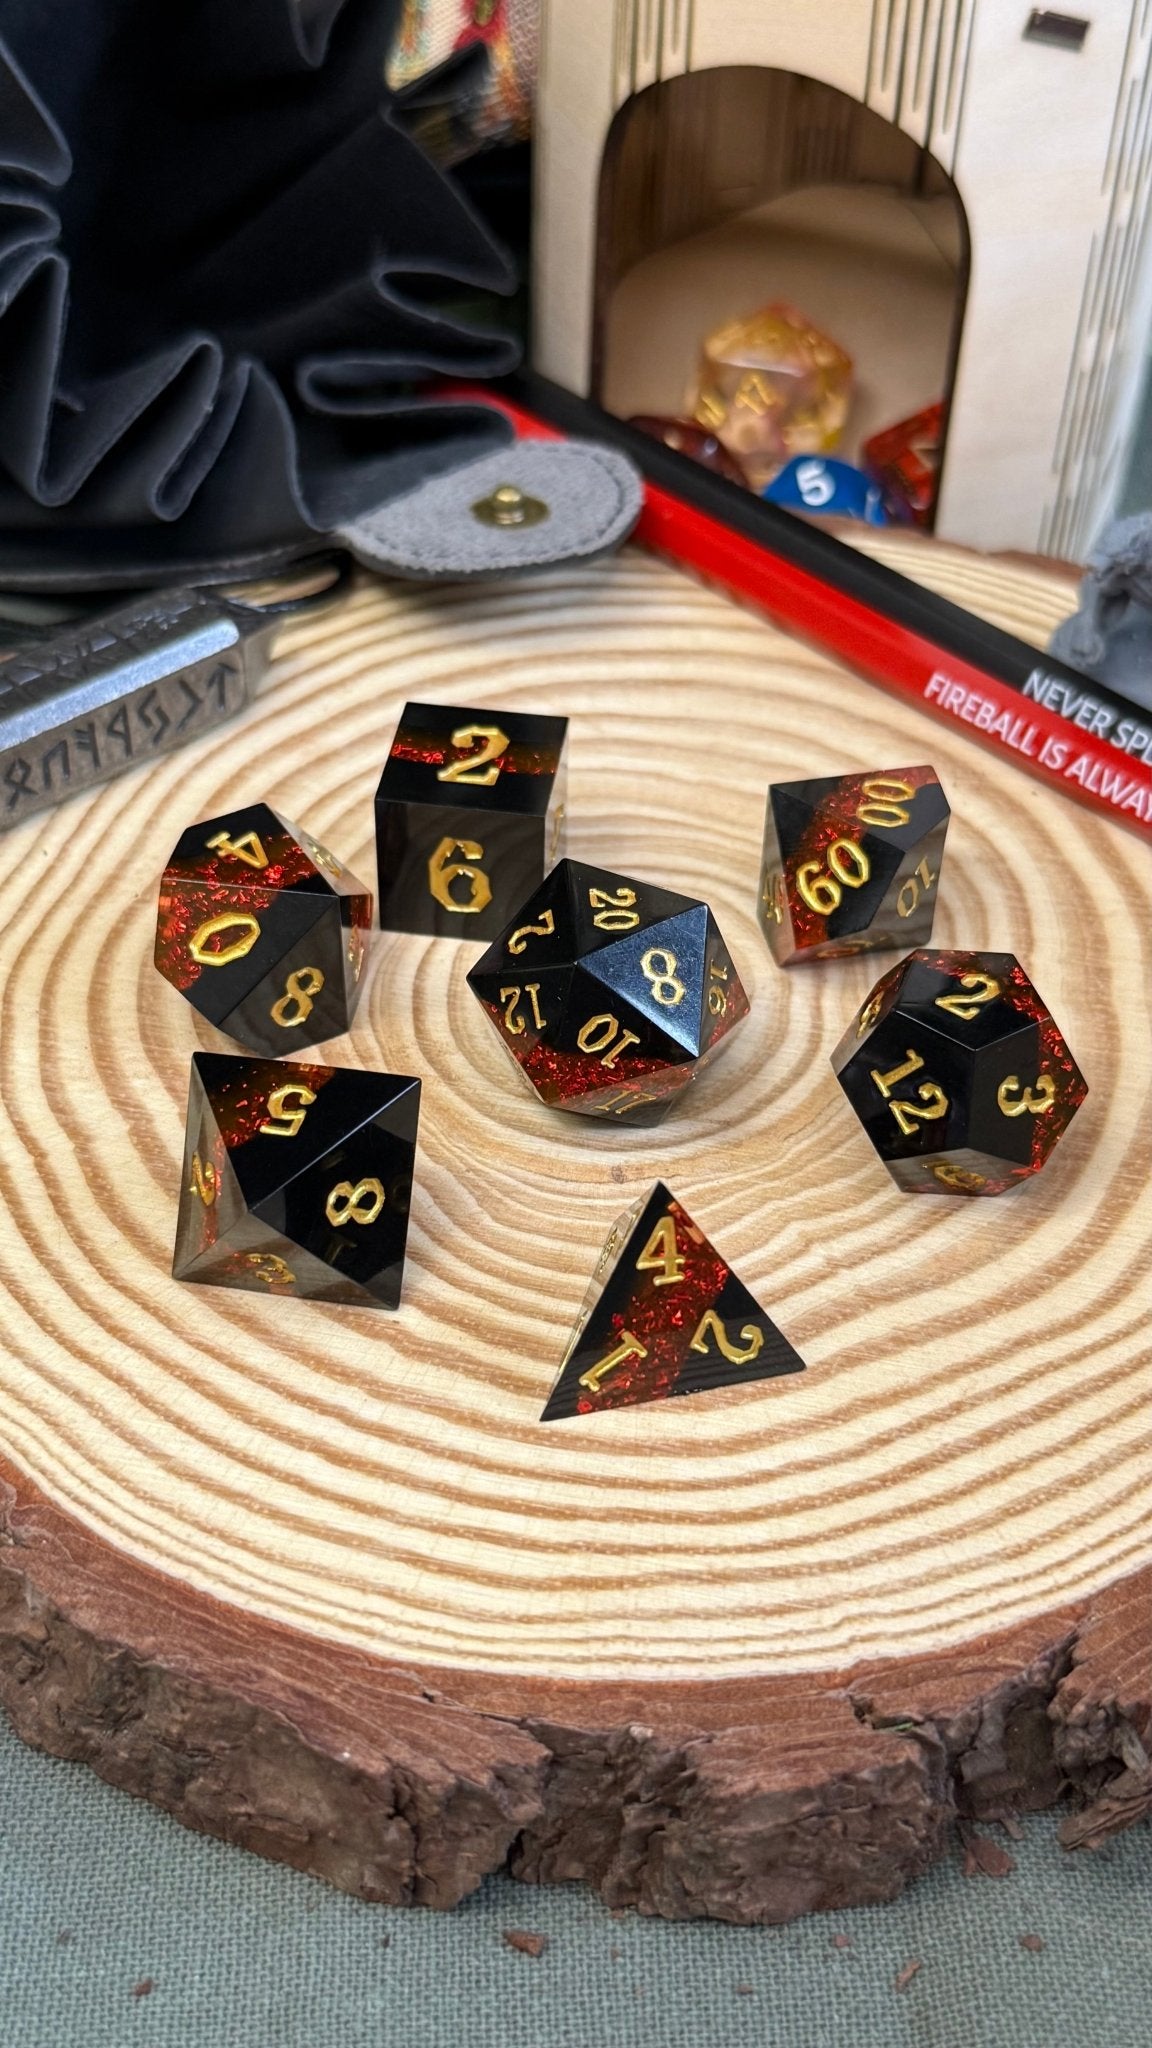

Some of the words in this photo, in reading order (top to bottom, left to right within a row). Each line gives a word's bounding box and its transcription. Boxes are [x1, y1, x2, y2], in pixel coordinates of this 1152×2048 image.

[796, 459, 836, 507] 5
[923, 672, 1039, 757] FIREBALL
[1037, 735, 1069, 771] IS
[1022, 668, 1114, 740] NEVER
[437, 725, 510, 786] 2
[857, 778, 916, 828] 00
[205, 831, 270, 869] 4
[428, 836, 493, 914] 6
[796, 838, 870, 916] 60
[588, 887, 641, 932] 20
[896, 859, 936, 918] 10
[189, 911, 262, 967] 0
[270, 966, 325, 1028] 8
[640, 947, 686, 1007] 8
[936, 973, 1000, 1020] 2
[500, 983, 547, 1035] 12
[577, 1013, 641, 1069] 10
[260, 1084, 318, 1137] 5
[870, 1048, 949, 1135] 12
[997, 1074, 1056, 1118] 3
[325, 1177, 386, 1228] 8
[636, 1216, 686, 1287] 4
[578, 1330, 649, 1392] 1
[690, 1310, 765, 1365] 2
